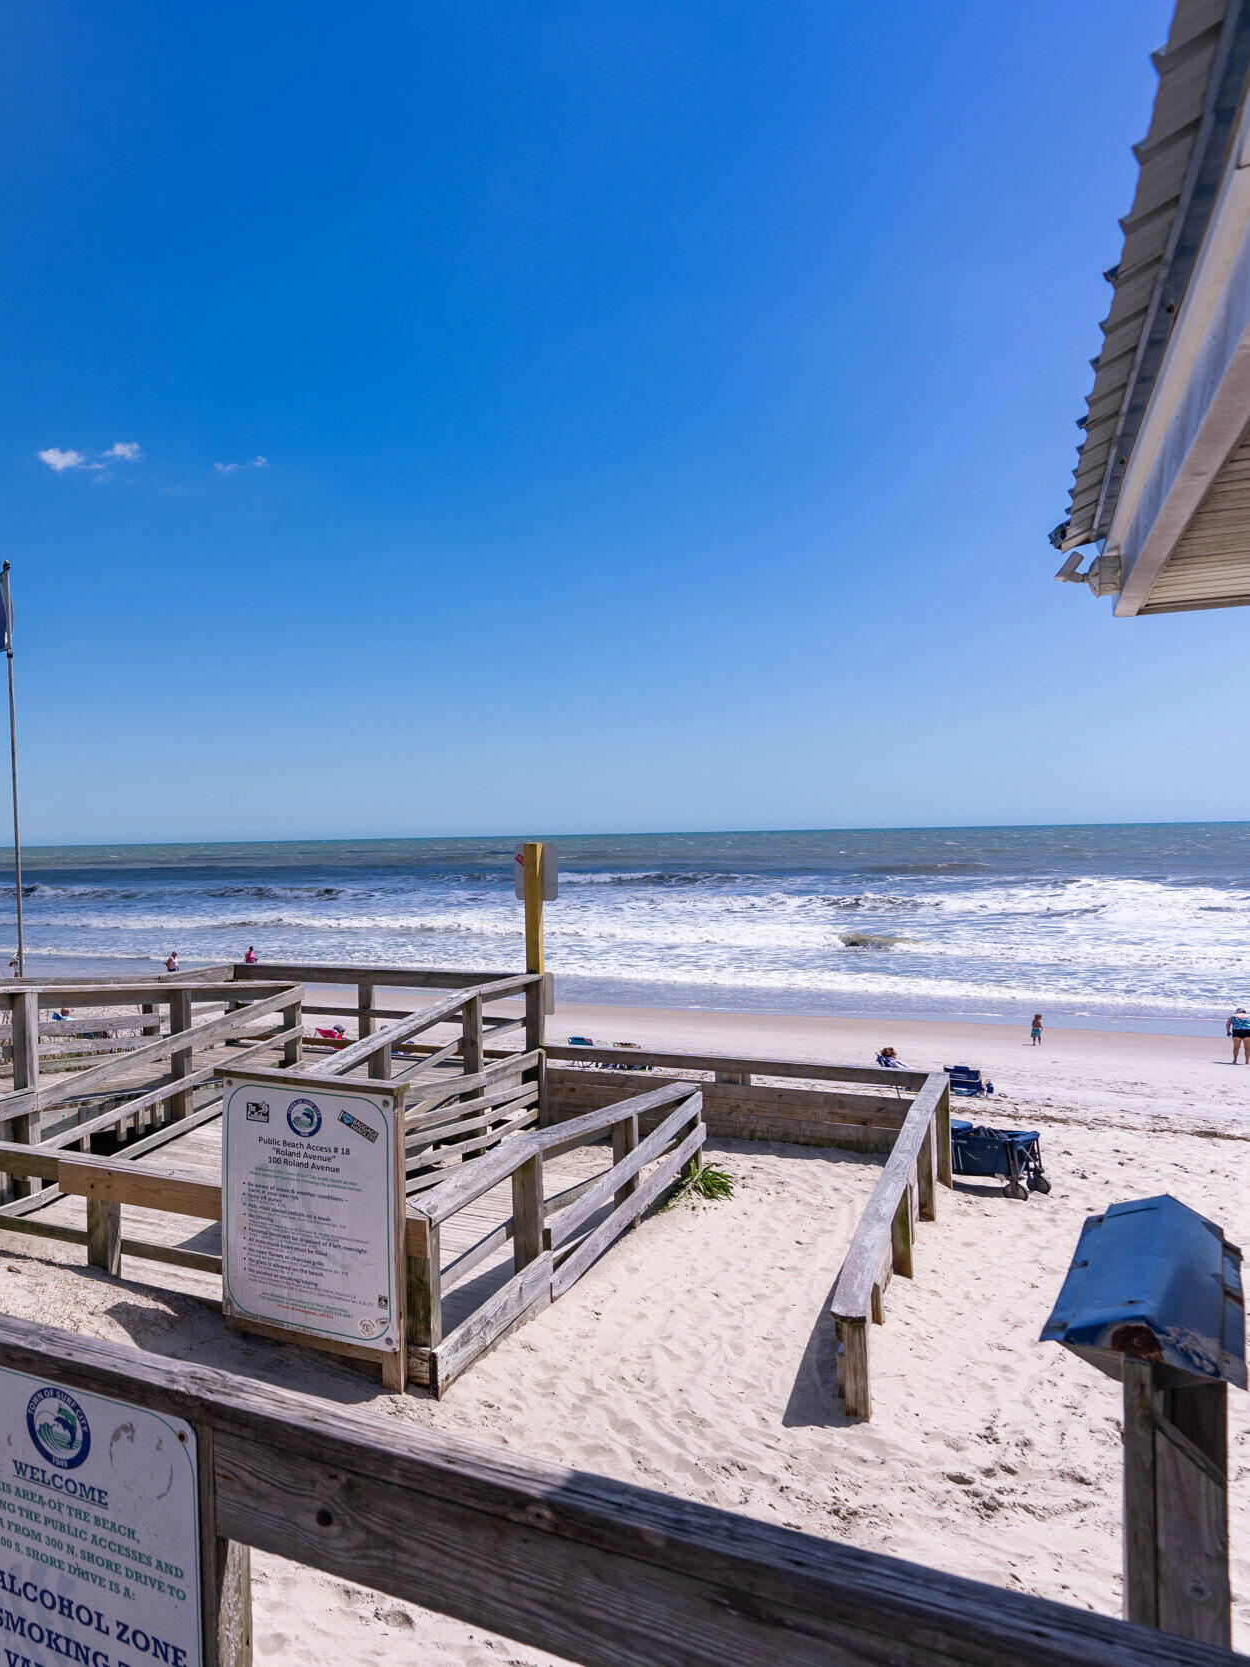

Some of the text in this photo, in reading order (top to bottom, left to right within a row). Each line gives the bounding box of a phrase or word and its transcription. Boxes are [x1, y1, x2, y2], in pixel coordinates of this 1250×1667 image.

[258, 1136, 280, 1146] Public
[282, 1140, 304, 1149] Beach
[306, 1144, 332, 1153] Access
[268, 1156, 340, 1173] 100 Roland Avenue
[28, 1390, 88, 1432] TOWN OF SURF CITY
[12, 1459, 108, 1506] WELCOME
[14, 1486, 44, 1505] AREA
[48, 1500, 64, 1512] OF
[66, 1505, 90, 1523] THE
[94, 1515, 140, 1544] BEACH,
[7, 1520, 42, 1542] FROM
[45, 1535, 63, 1551] 300
[66, 1544, 77, 1557] N.
[80, 1550, 122, 1575] SHORE
[124, 1567, 166, 1593] DRIVE
[167, 1584, 186, 1601] TO
[18, 1506, 41, 1523] THE
[43, 1516, 87, 1541] PUBLIC
[91, 1534, 152, 1567] ACCESSES
[155, 1559, 184, 1579] AND
[15, 1542, 24, 1555] S.
[26, 1547, 65, 1571] SHORE
[68, 1562, 106, 1588] DRIVE
[109, 1580, 120, 1594] IS
[123, 1587, 136, 1600] A:
[116, 1620, 186, 1667] ZONE
